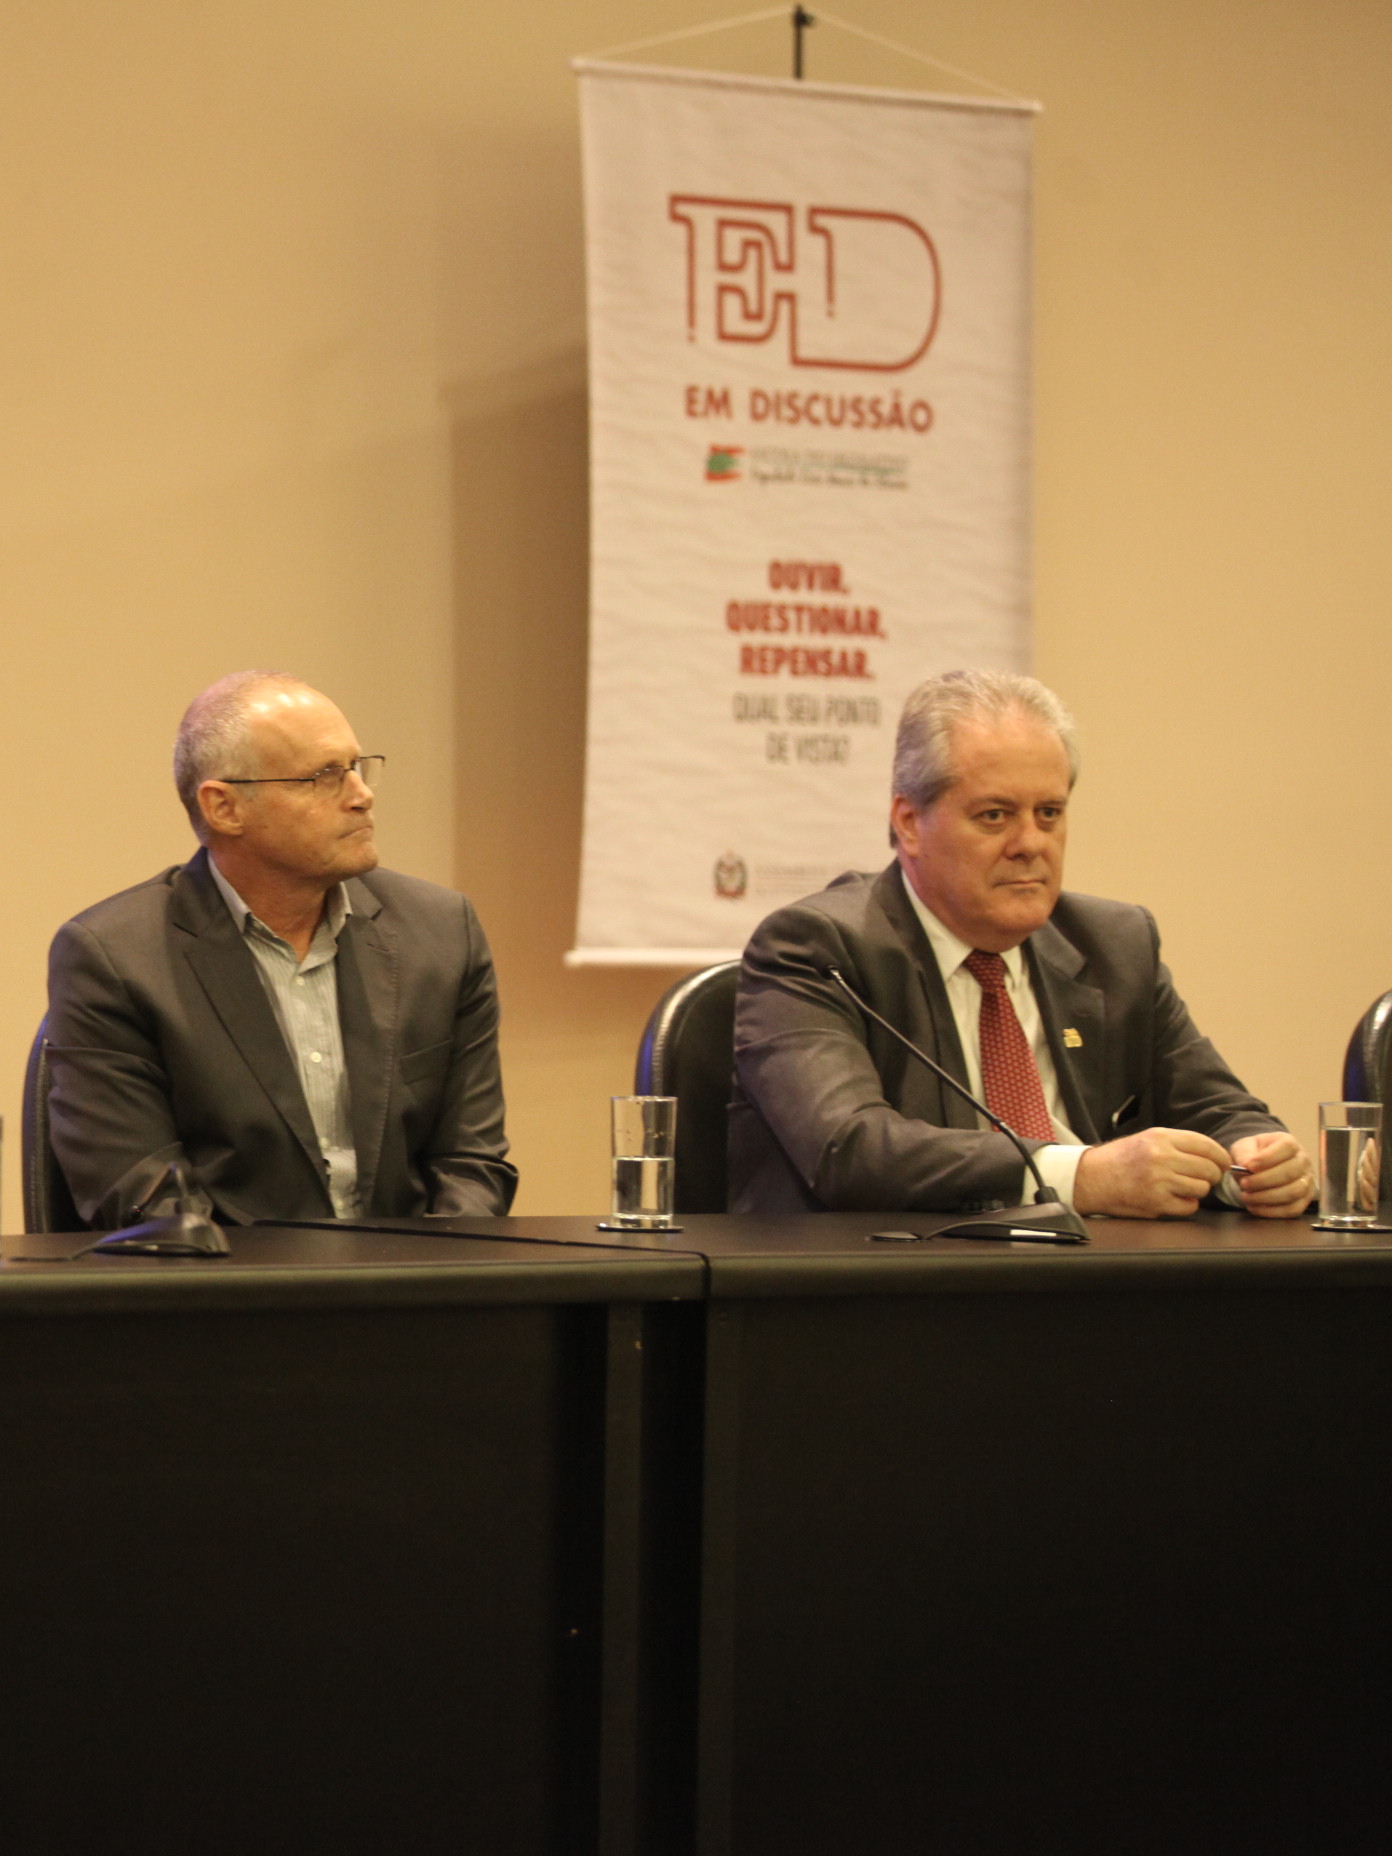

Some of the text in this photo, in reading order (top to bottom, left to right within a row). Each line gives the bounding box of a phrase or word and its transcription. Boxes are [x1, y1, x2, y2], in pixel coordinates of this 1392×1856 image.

[684, 384, 934, 434] EM DISCUSSÃO
[733, 692, 883, 728] QUAL SEU PONTO
[765, 731, 790, 765] DE
